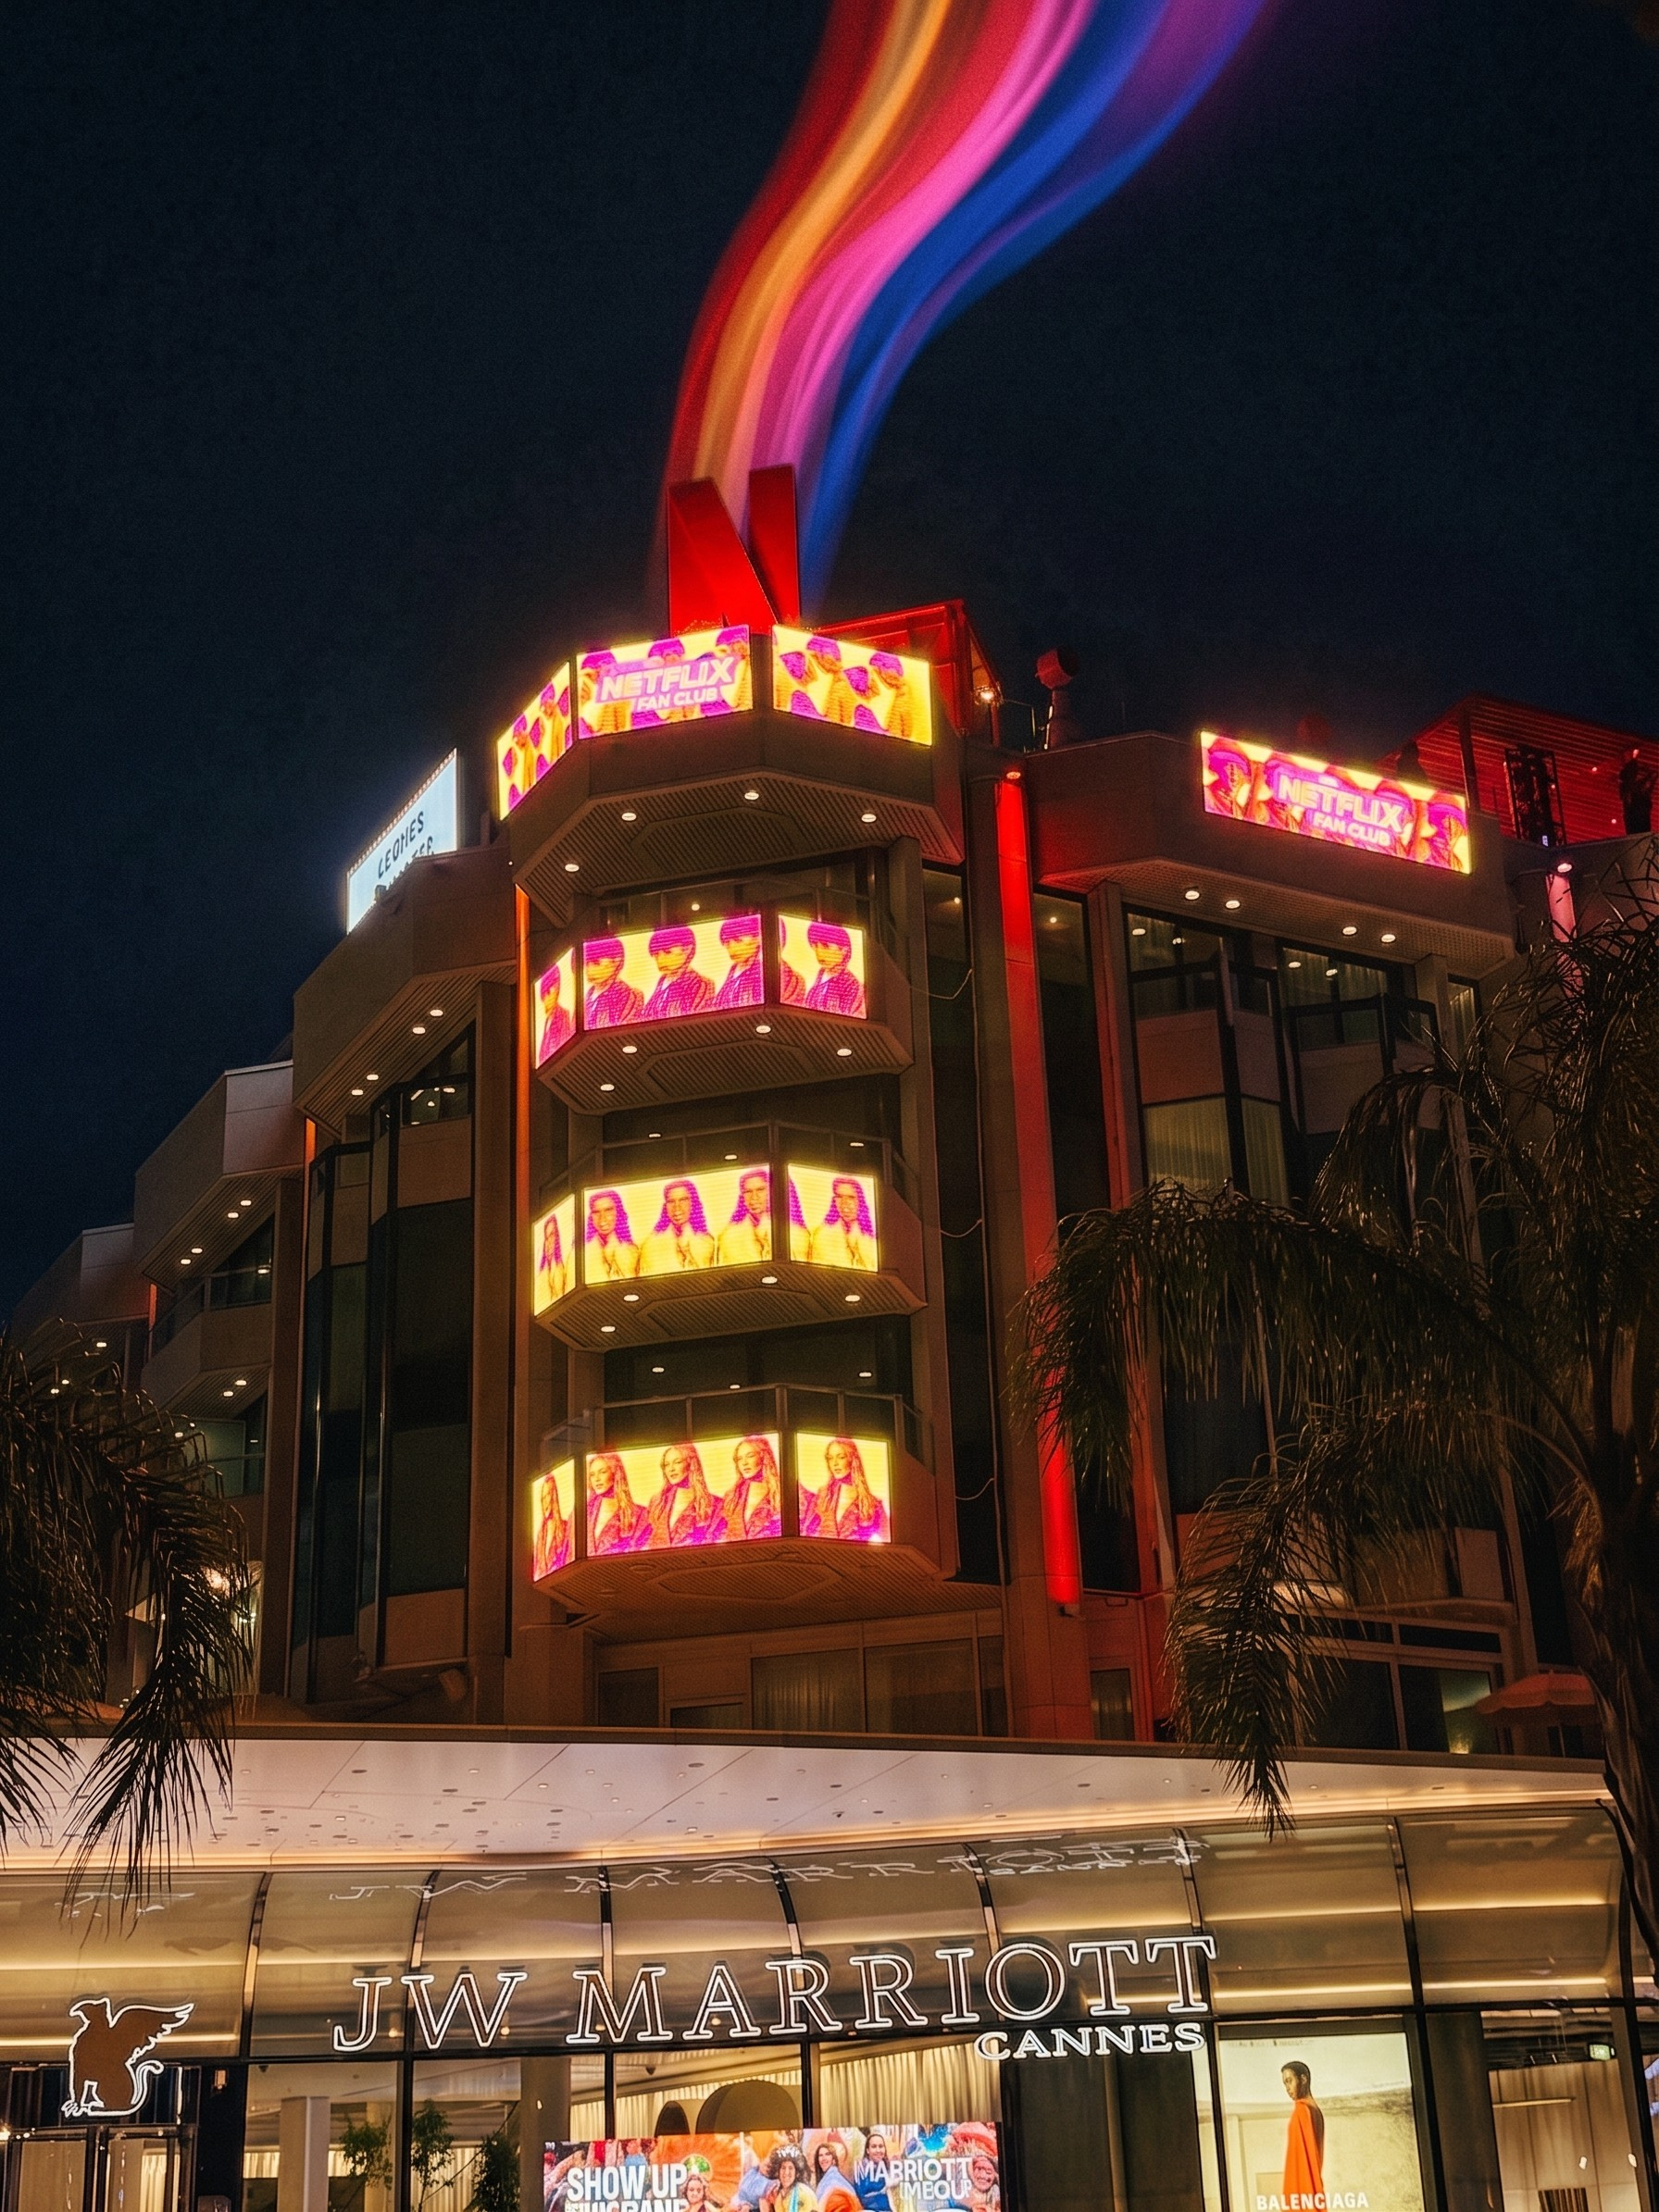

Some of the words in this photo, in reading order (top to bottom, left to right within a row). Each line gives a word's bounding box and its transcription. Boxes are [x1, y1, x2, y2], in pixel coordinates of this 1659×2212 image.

[601, 656, 734, 701] NETFLIX
[636, 693, 670, 711] FAN
[673, 688, 718, 706] CLUB
[1278, 774, 1404, 832] NETFLIX
[1313, 811, 1346, 834] FAN
[332, 1971, 529, 2052] JW
[566, 1935, 1217, 2044] MARRIOTT
[973, 2021, 1205, 2060] CANNES
[567, 2164, 646, 2201] SHOW
[651, 2163, 687, 2198] UP
[1256, 2192, 1369, 2211] BALENCIAGA
